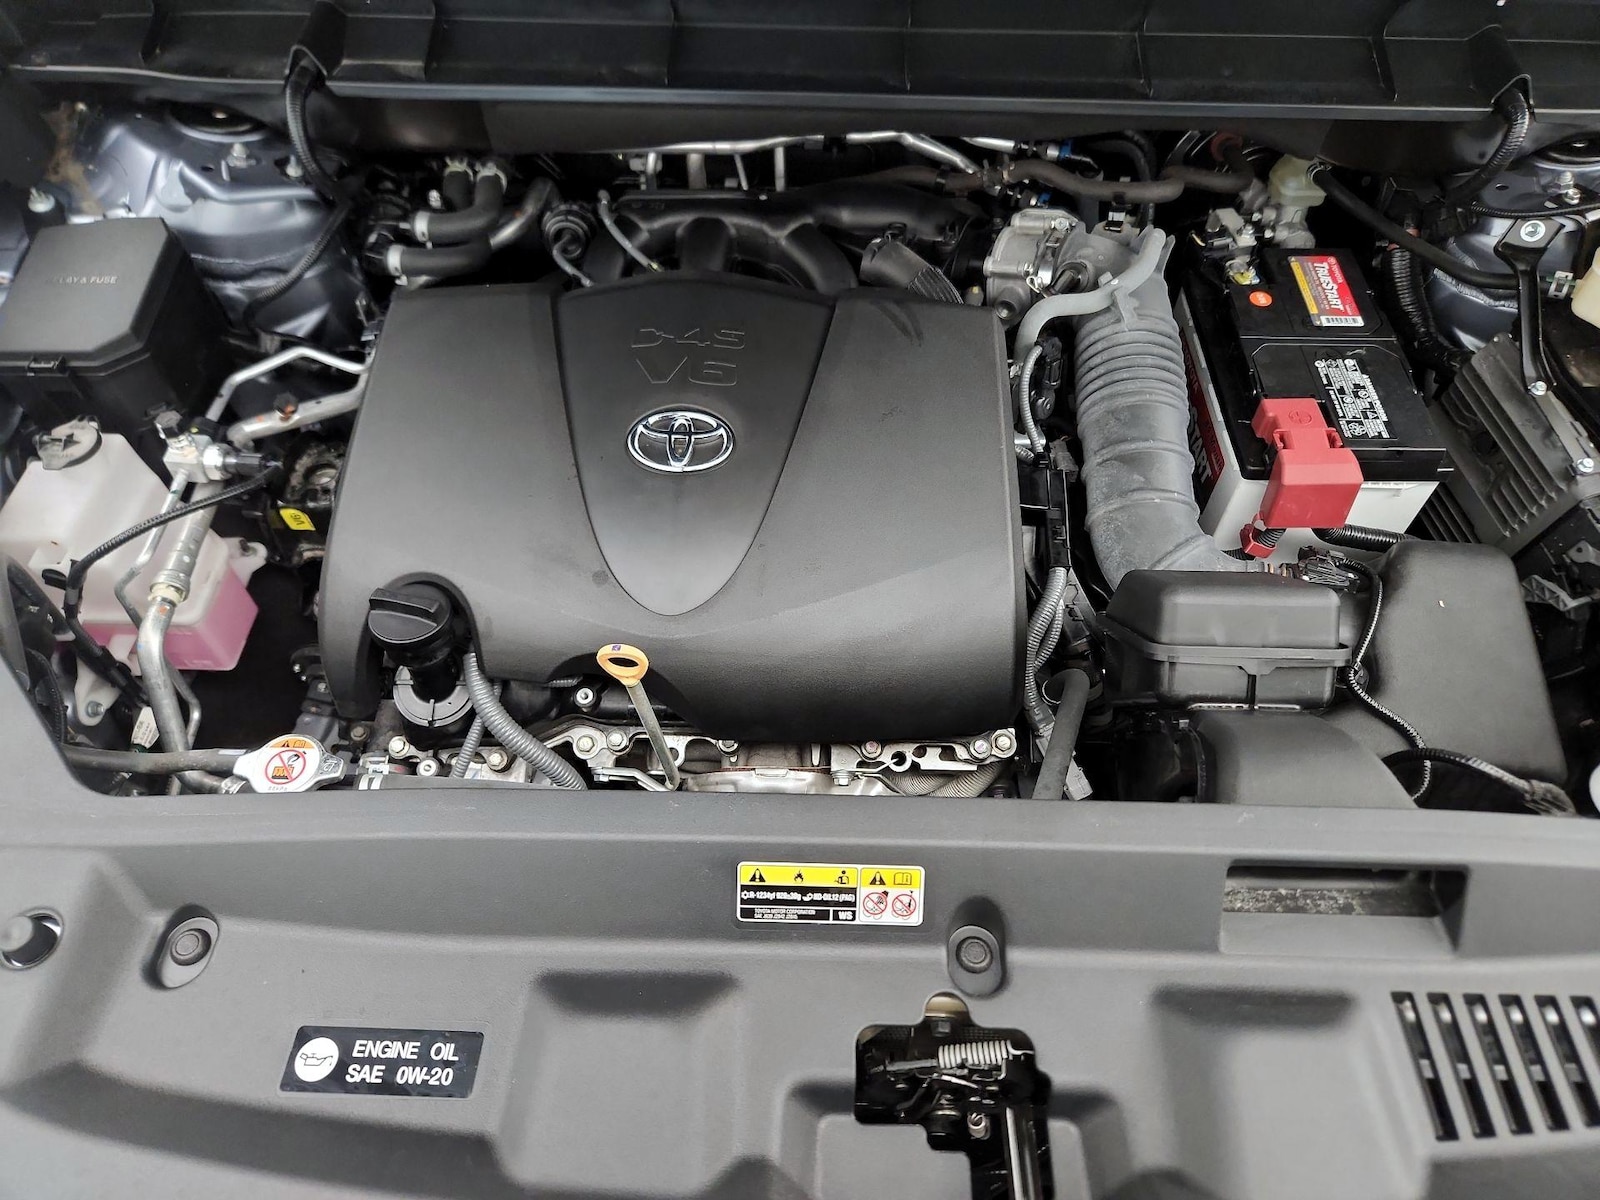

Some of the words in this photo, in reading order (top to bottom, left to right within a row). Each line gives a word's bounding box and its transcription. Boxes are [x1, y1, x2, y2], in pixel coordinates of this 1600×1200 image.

[90, 275, 118, 285] FUSE
[636, 356, 738, 387] V6
[838, 911, 853, 920] WS
[352, 1039, 420, 1060] ENGINE
[430, 1042, 459, 1061] OIL
[345, 1064, 385, 1084] SAE
[396, 1066, 453, 1086] 0W-20
